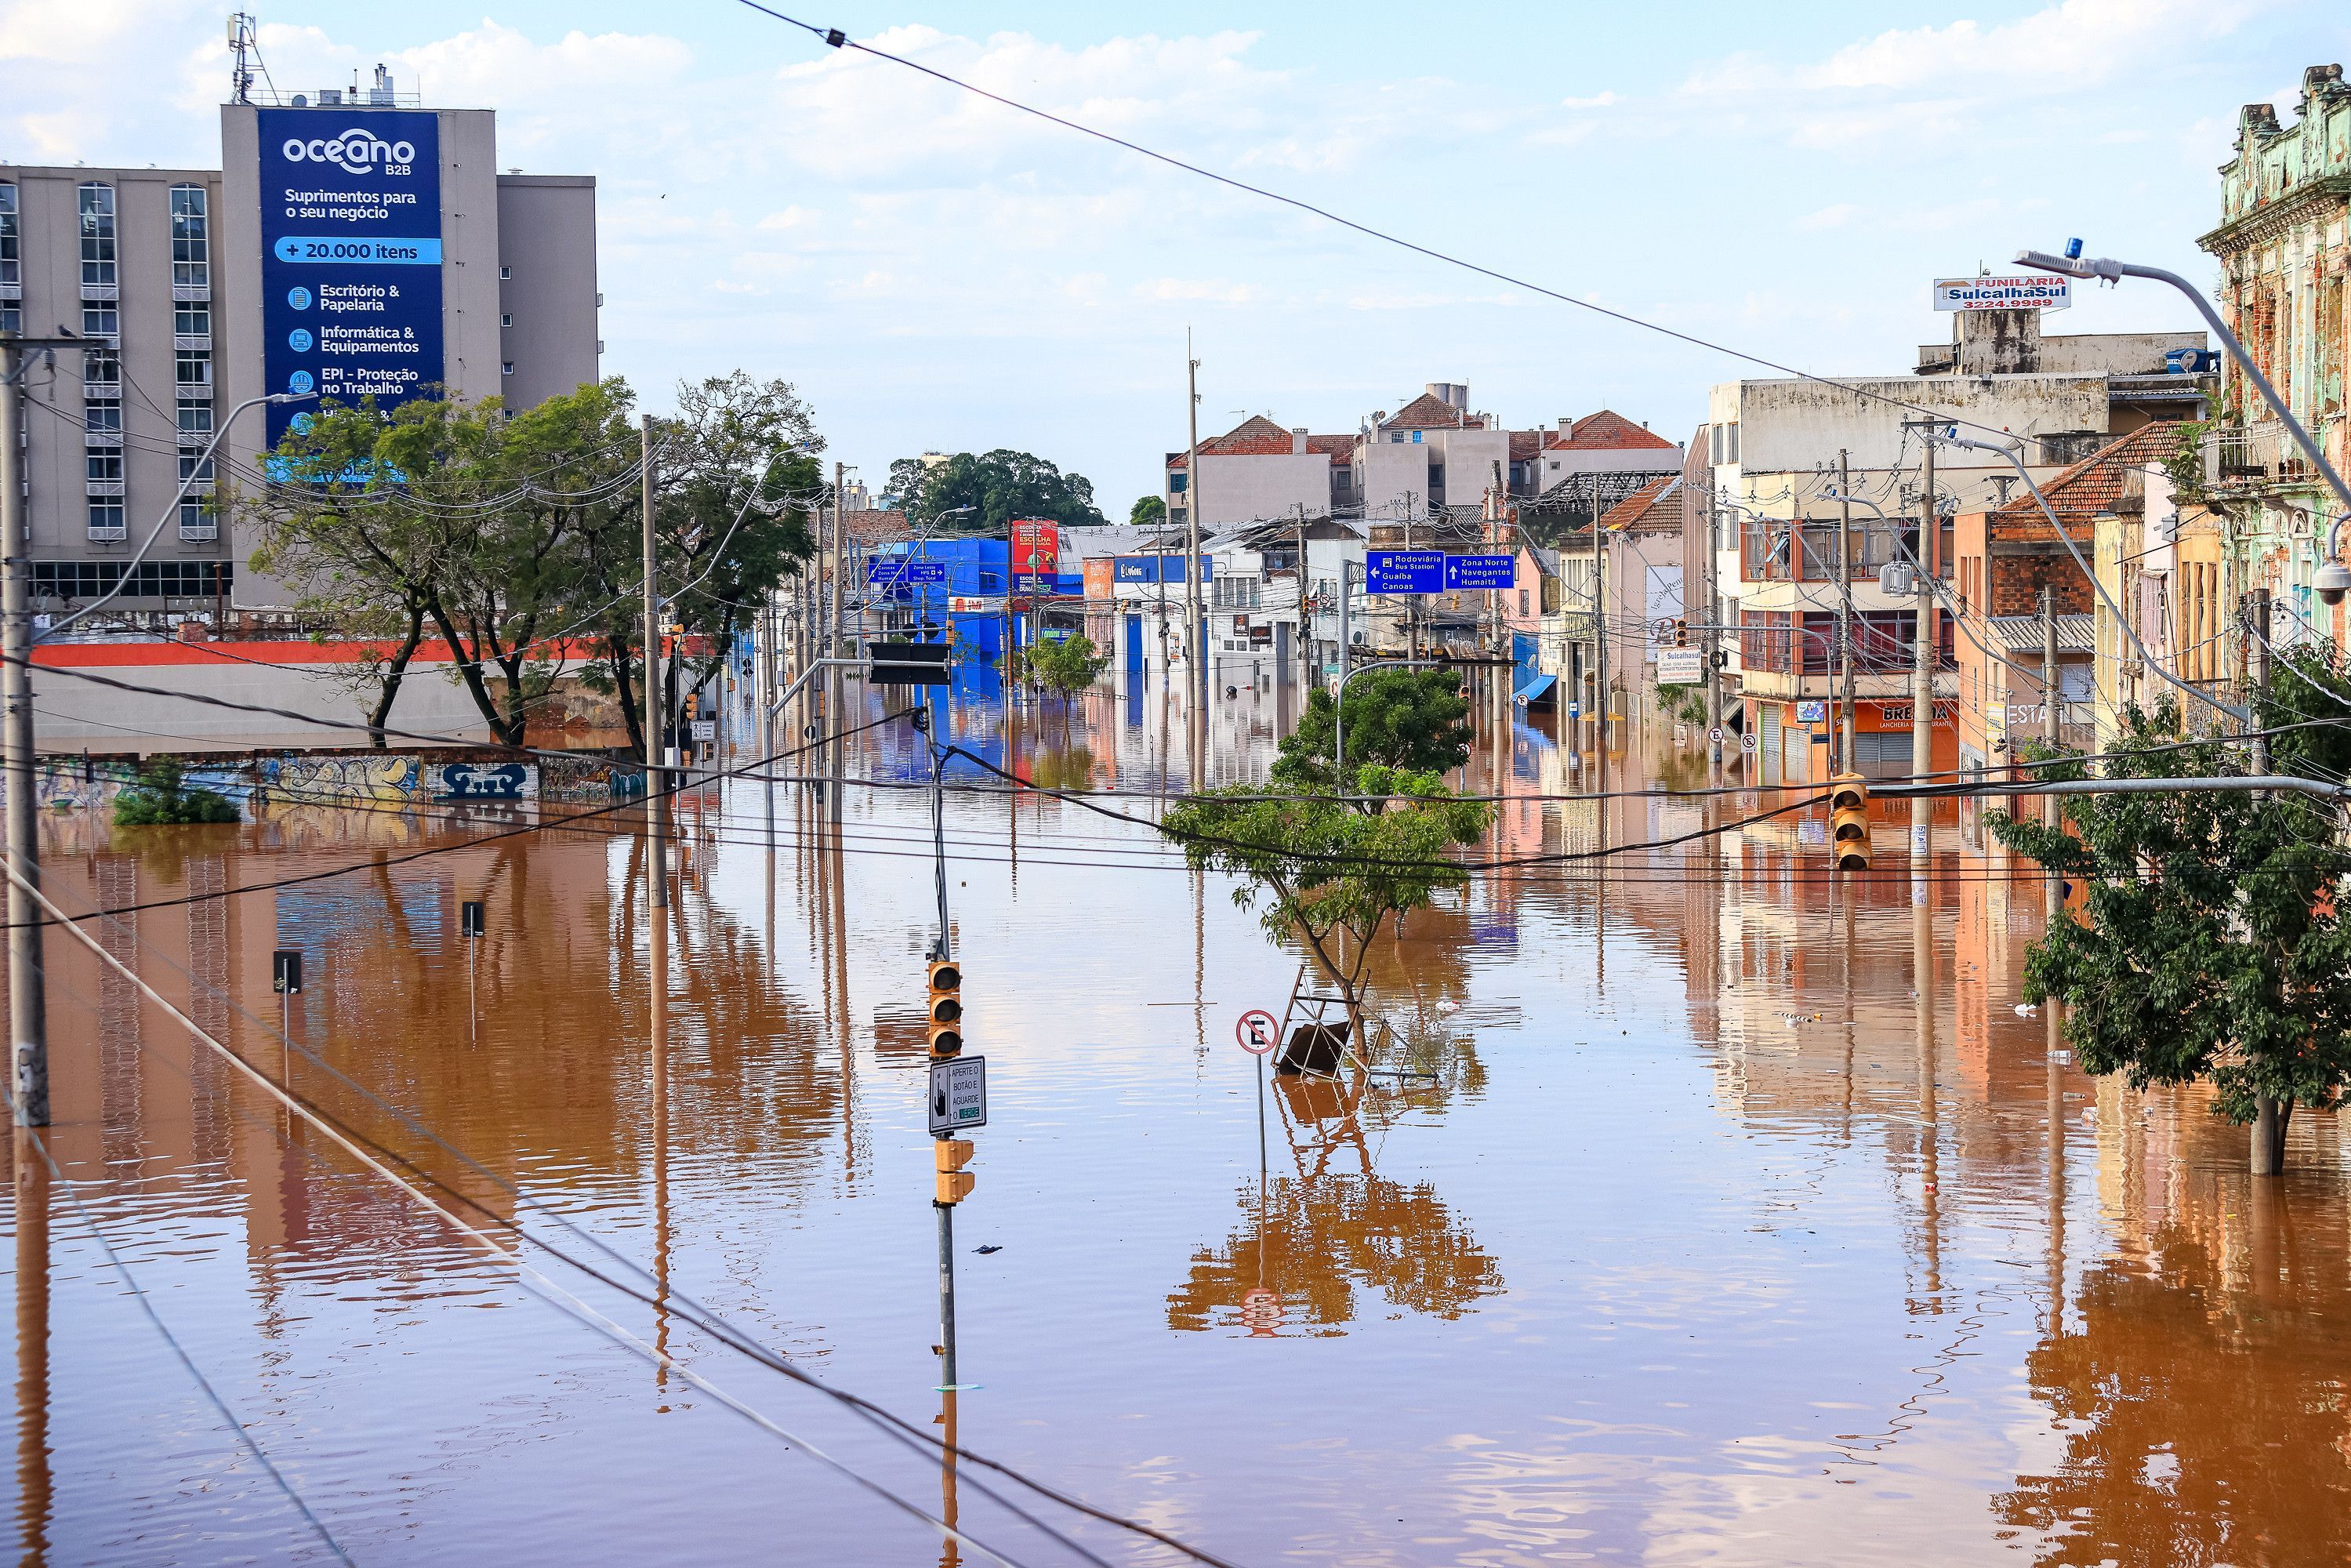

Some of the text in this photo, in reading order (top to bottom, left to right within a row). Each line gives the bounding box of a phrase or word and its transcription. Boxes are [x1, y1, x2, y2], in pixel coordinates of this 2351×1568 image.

[283, 132, 415, 171] oceano
[386, 165, 412, 176] B2B
[285, 189, 416, 206] Suprimentos para
[285, 206, 389, 222] o seu negócio
[306, 244, 371, 258] 20.000
[376, 244, 418, 259] itens
[1975, 277, 2066, 288] FUNILARIA
[320, 285, 400, 297] Escritório &
[1949, 286, 2066, 299] SulcalhaSul
[320, 298, 384, 313] Papelaria
[1963, 299, 2052, 309] 3224.9989
[321, 325, 414, 339] Informática &
[321, 339, 419, 354] Equipamentos
[321, 368, 343, 380] EPI
[357, 368, 418, 383] Proteção
[321, 382, 404, 394] no Trabalho
[1382, 572, 1412, 581] Guaíba
[1651, 587, 1668, 610] Igreja
[1250, 1021, 1265, 1044] E
[952, 1066, 973, 1077] APERTE
[954, 1080, 972, 1091] BOTÃO
[952, 1094, 979, 1105] AGUARDE
[953, 1108, 979, 1120] O VERDE
